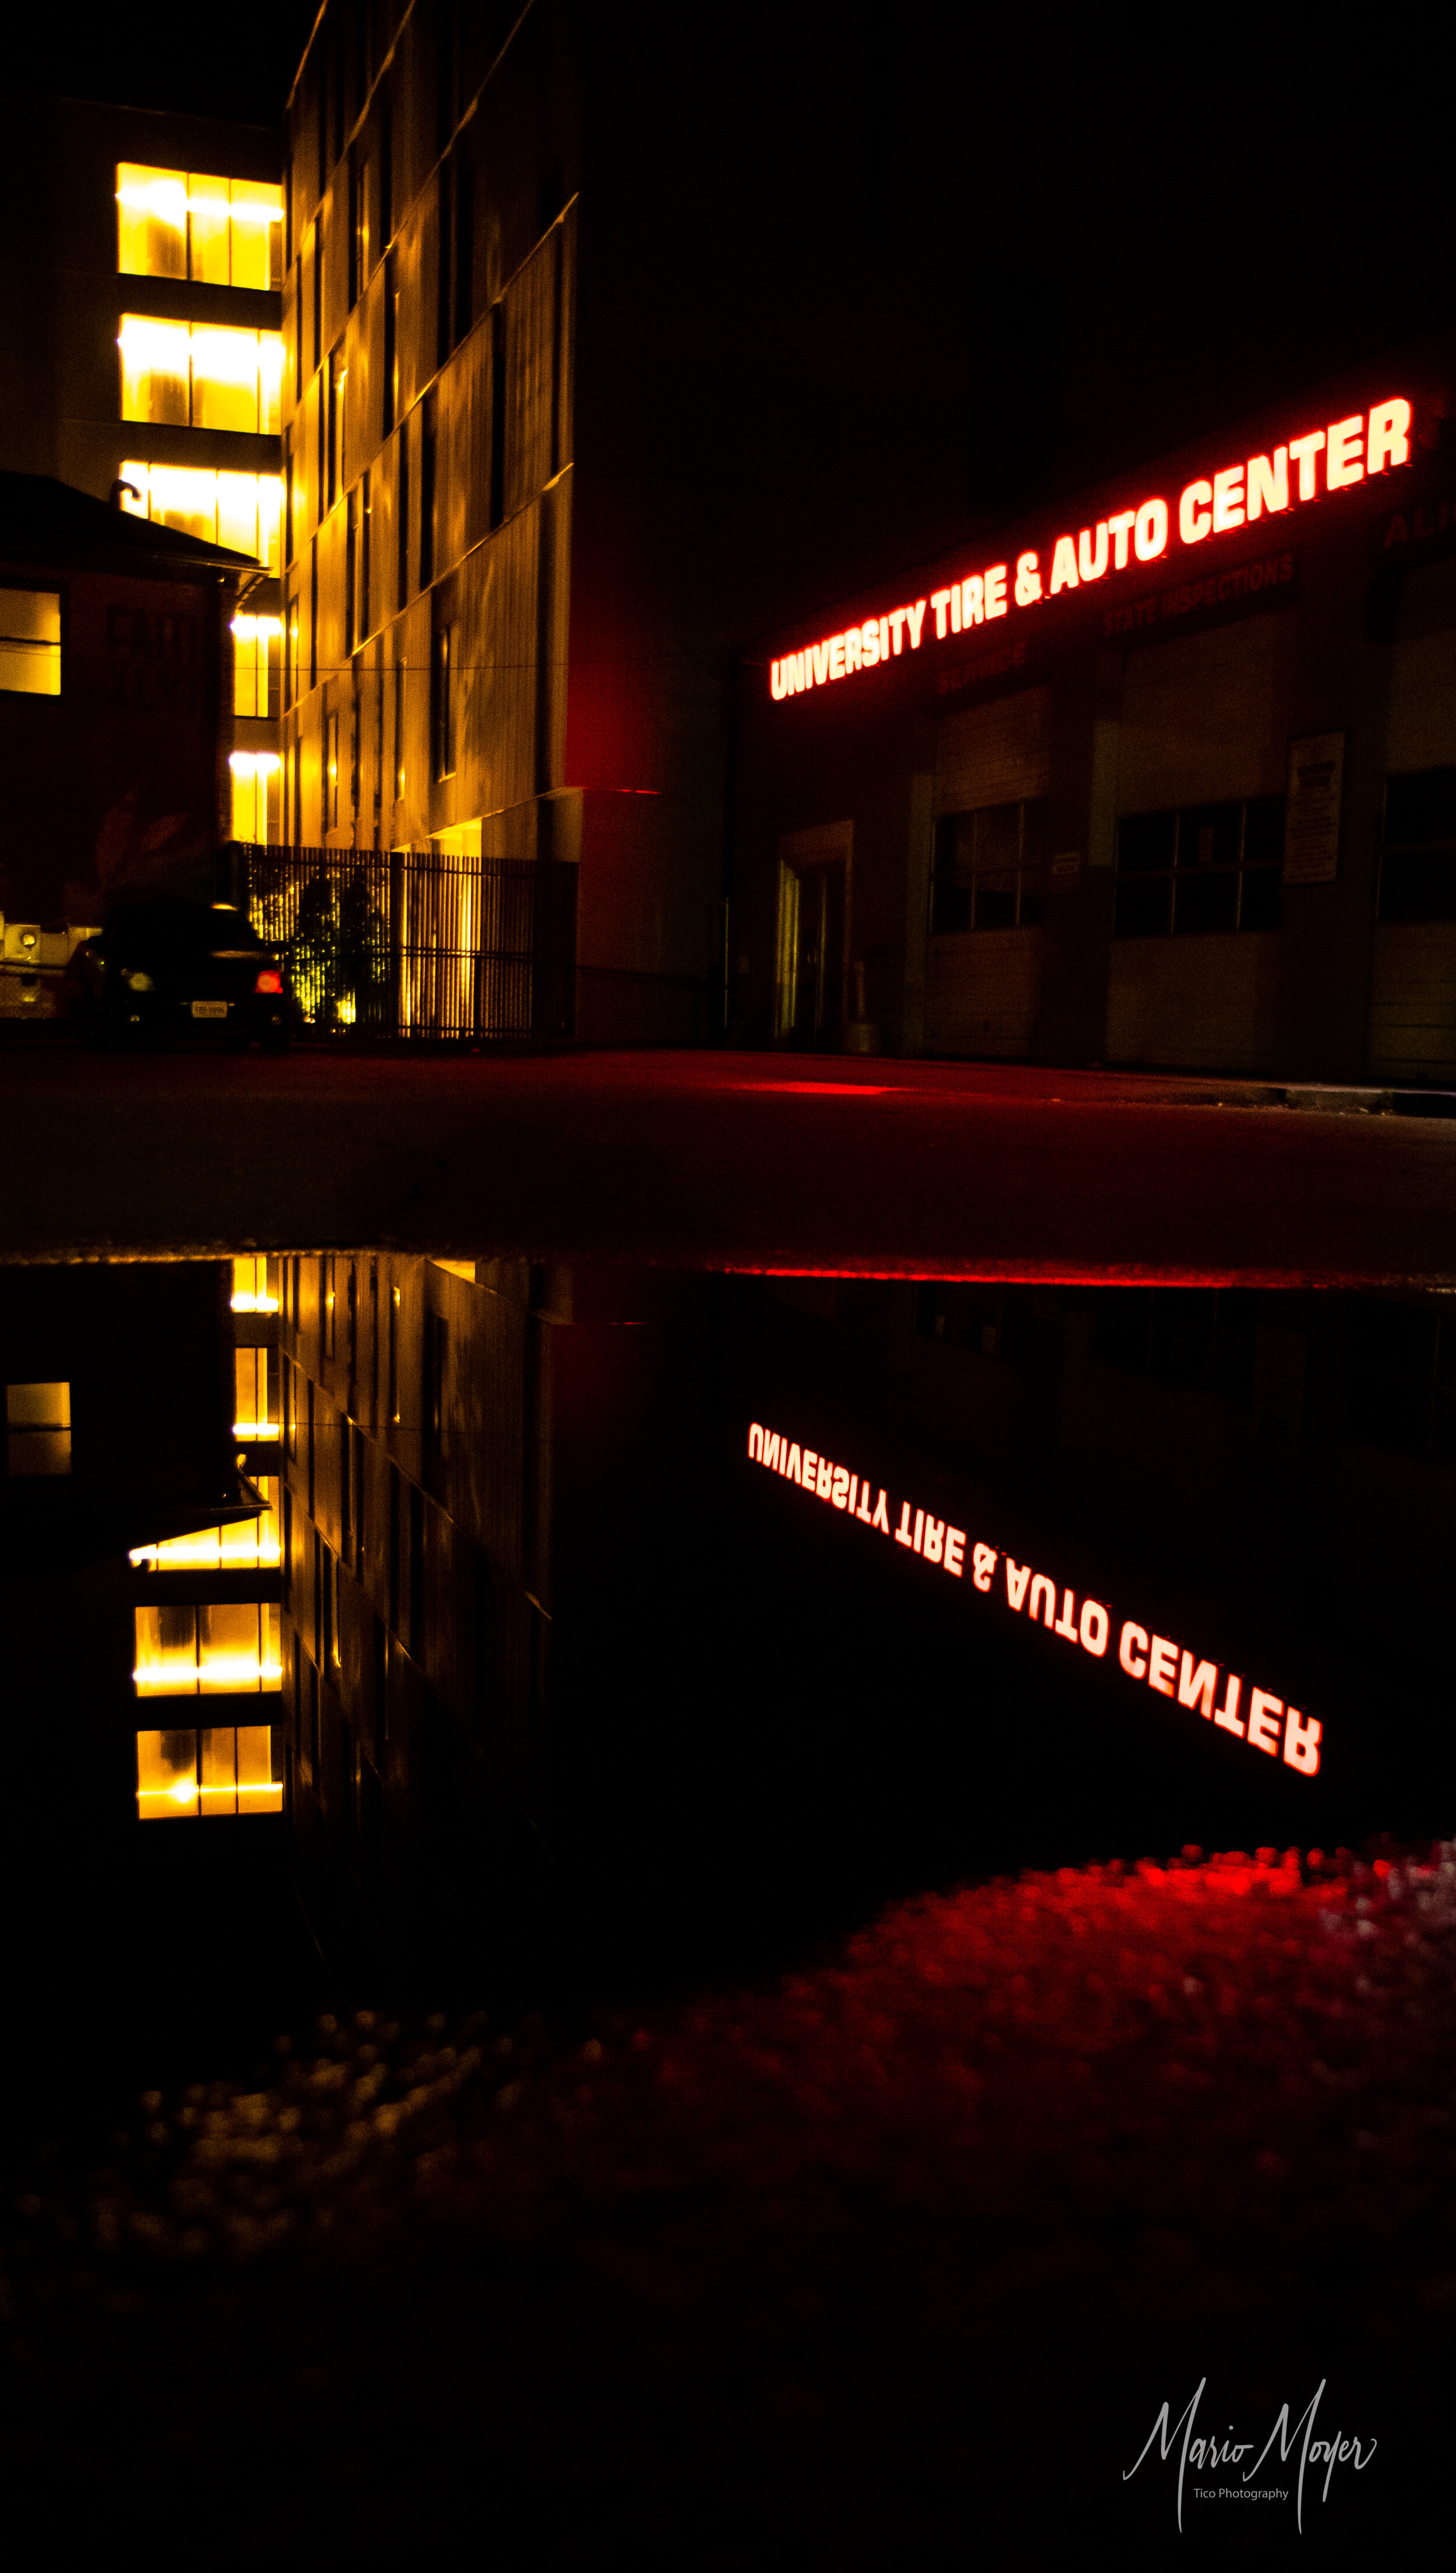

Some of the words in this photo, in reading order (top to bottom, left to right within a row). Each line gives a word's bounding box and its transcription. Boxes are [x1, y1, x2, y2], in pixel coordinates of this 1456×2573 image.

[770, 599, 927, 700] UNIVERSITY
[930, 564, 1008, 640] TIRE
[1013, 550, 1044, 607] &
[1049, 498, 1168, 595] AUTO
[1178, 397, 1411, 545] CENTER
[1102, 597, 1156, 637] STATE
[1161, 553, 1294, 619] INSPECTIONS
